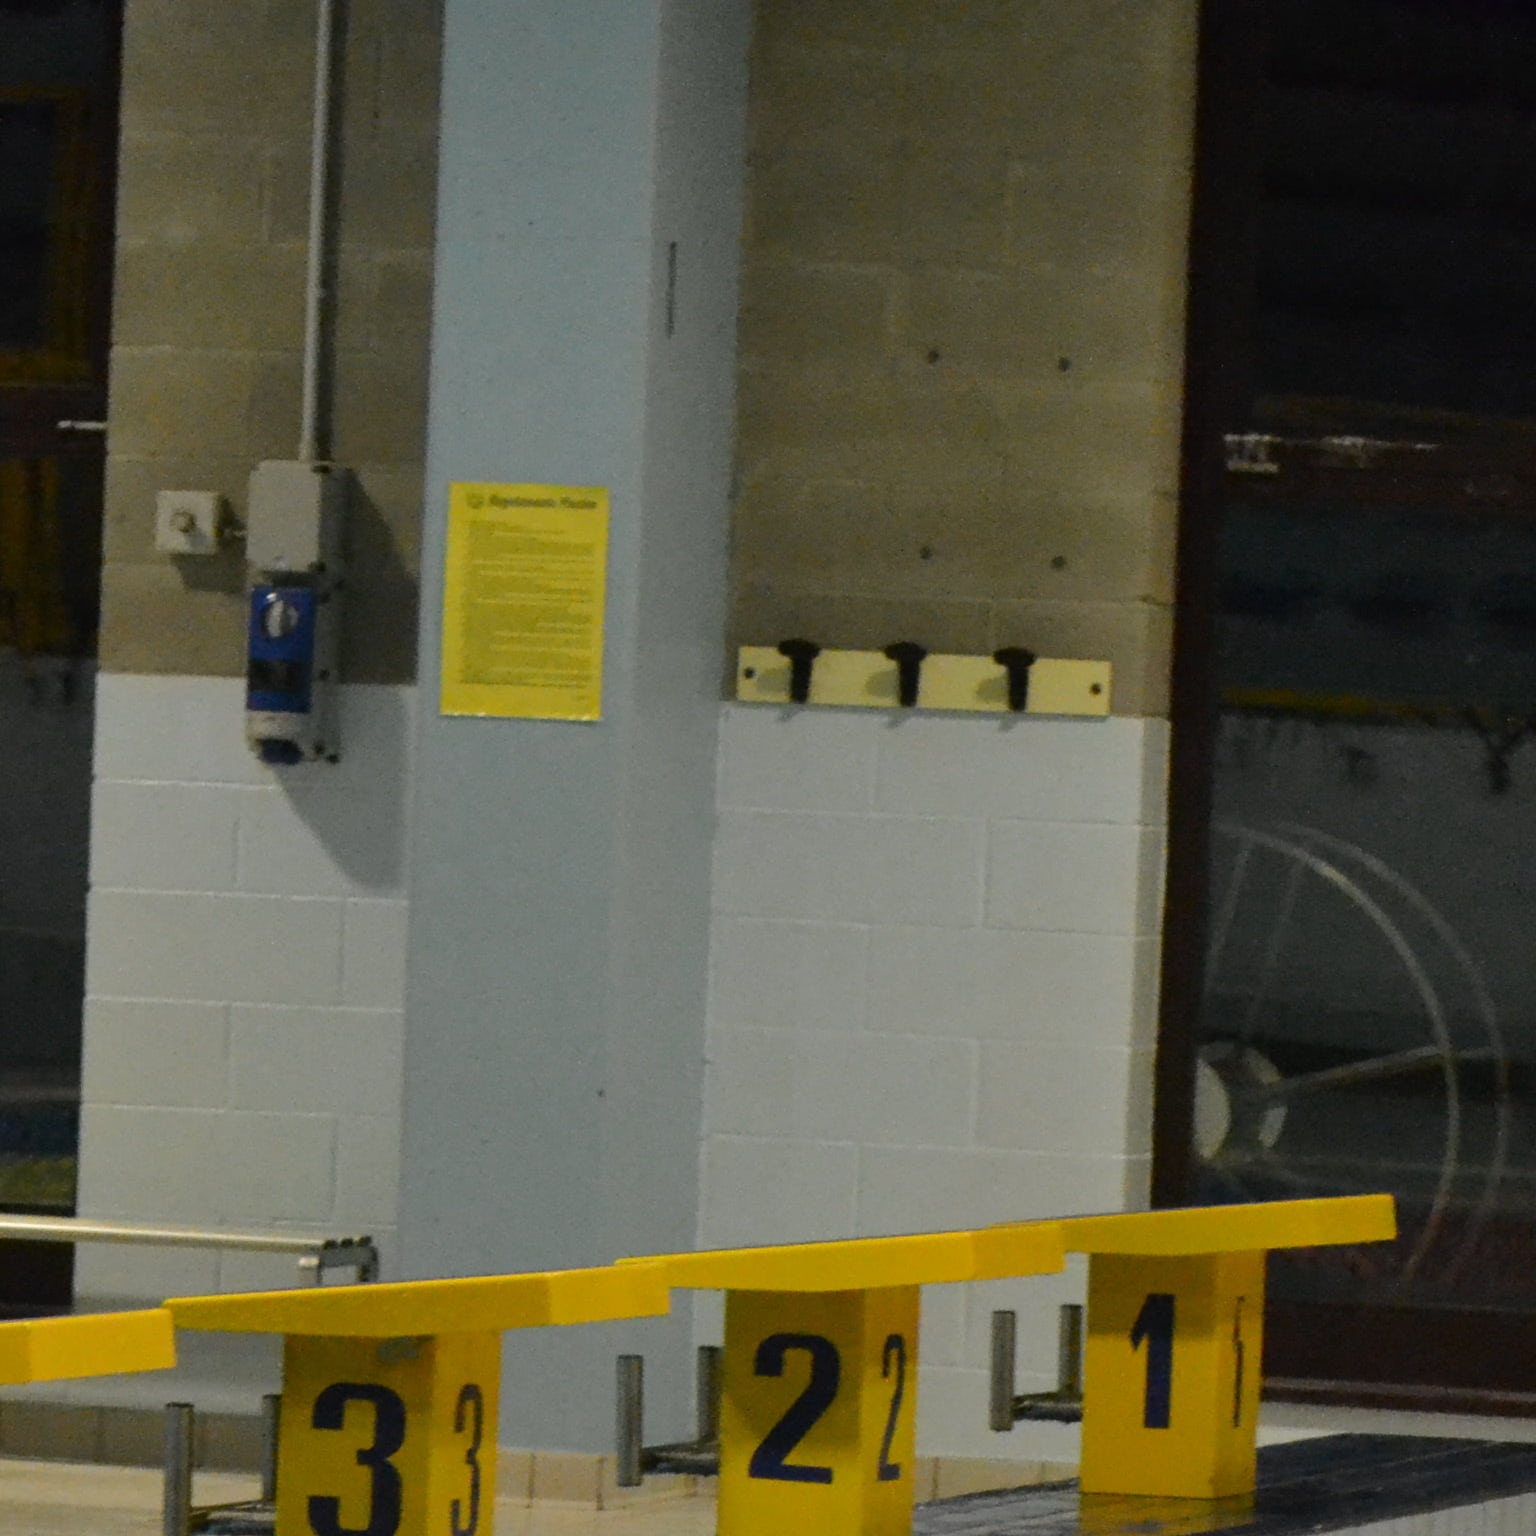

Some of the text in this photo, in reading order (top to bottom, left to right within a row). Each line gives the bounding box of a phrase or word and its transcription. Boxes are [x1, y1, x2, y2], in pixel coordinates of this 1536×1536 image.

[749, 1333, 841, 1484] 2
[879, 1334, 907, 1481] 2
[1132, 1294, 1176, 1429] 1
[1233, 1295, 1246, 1429] 1
